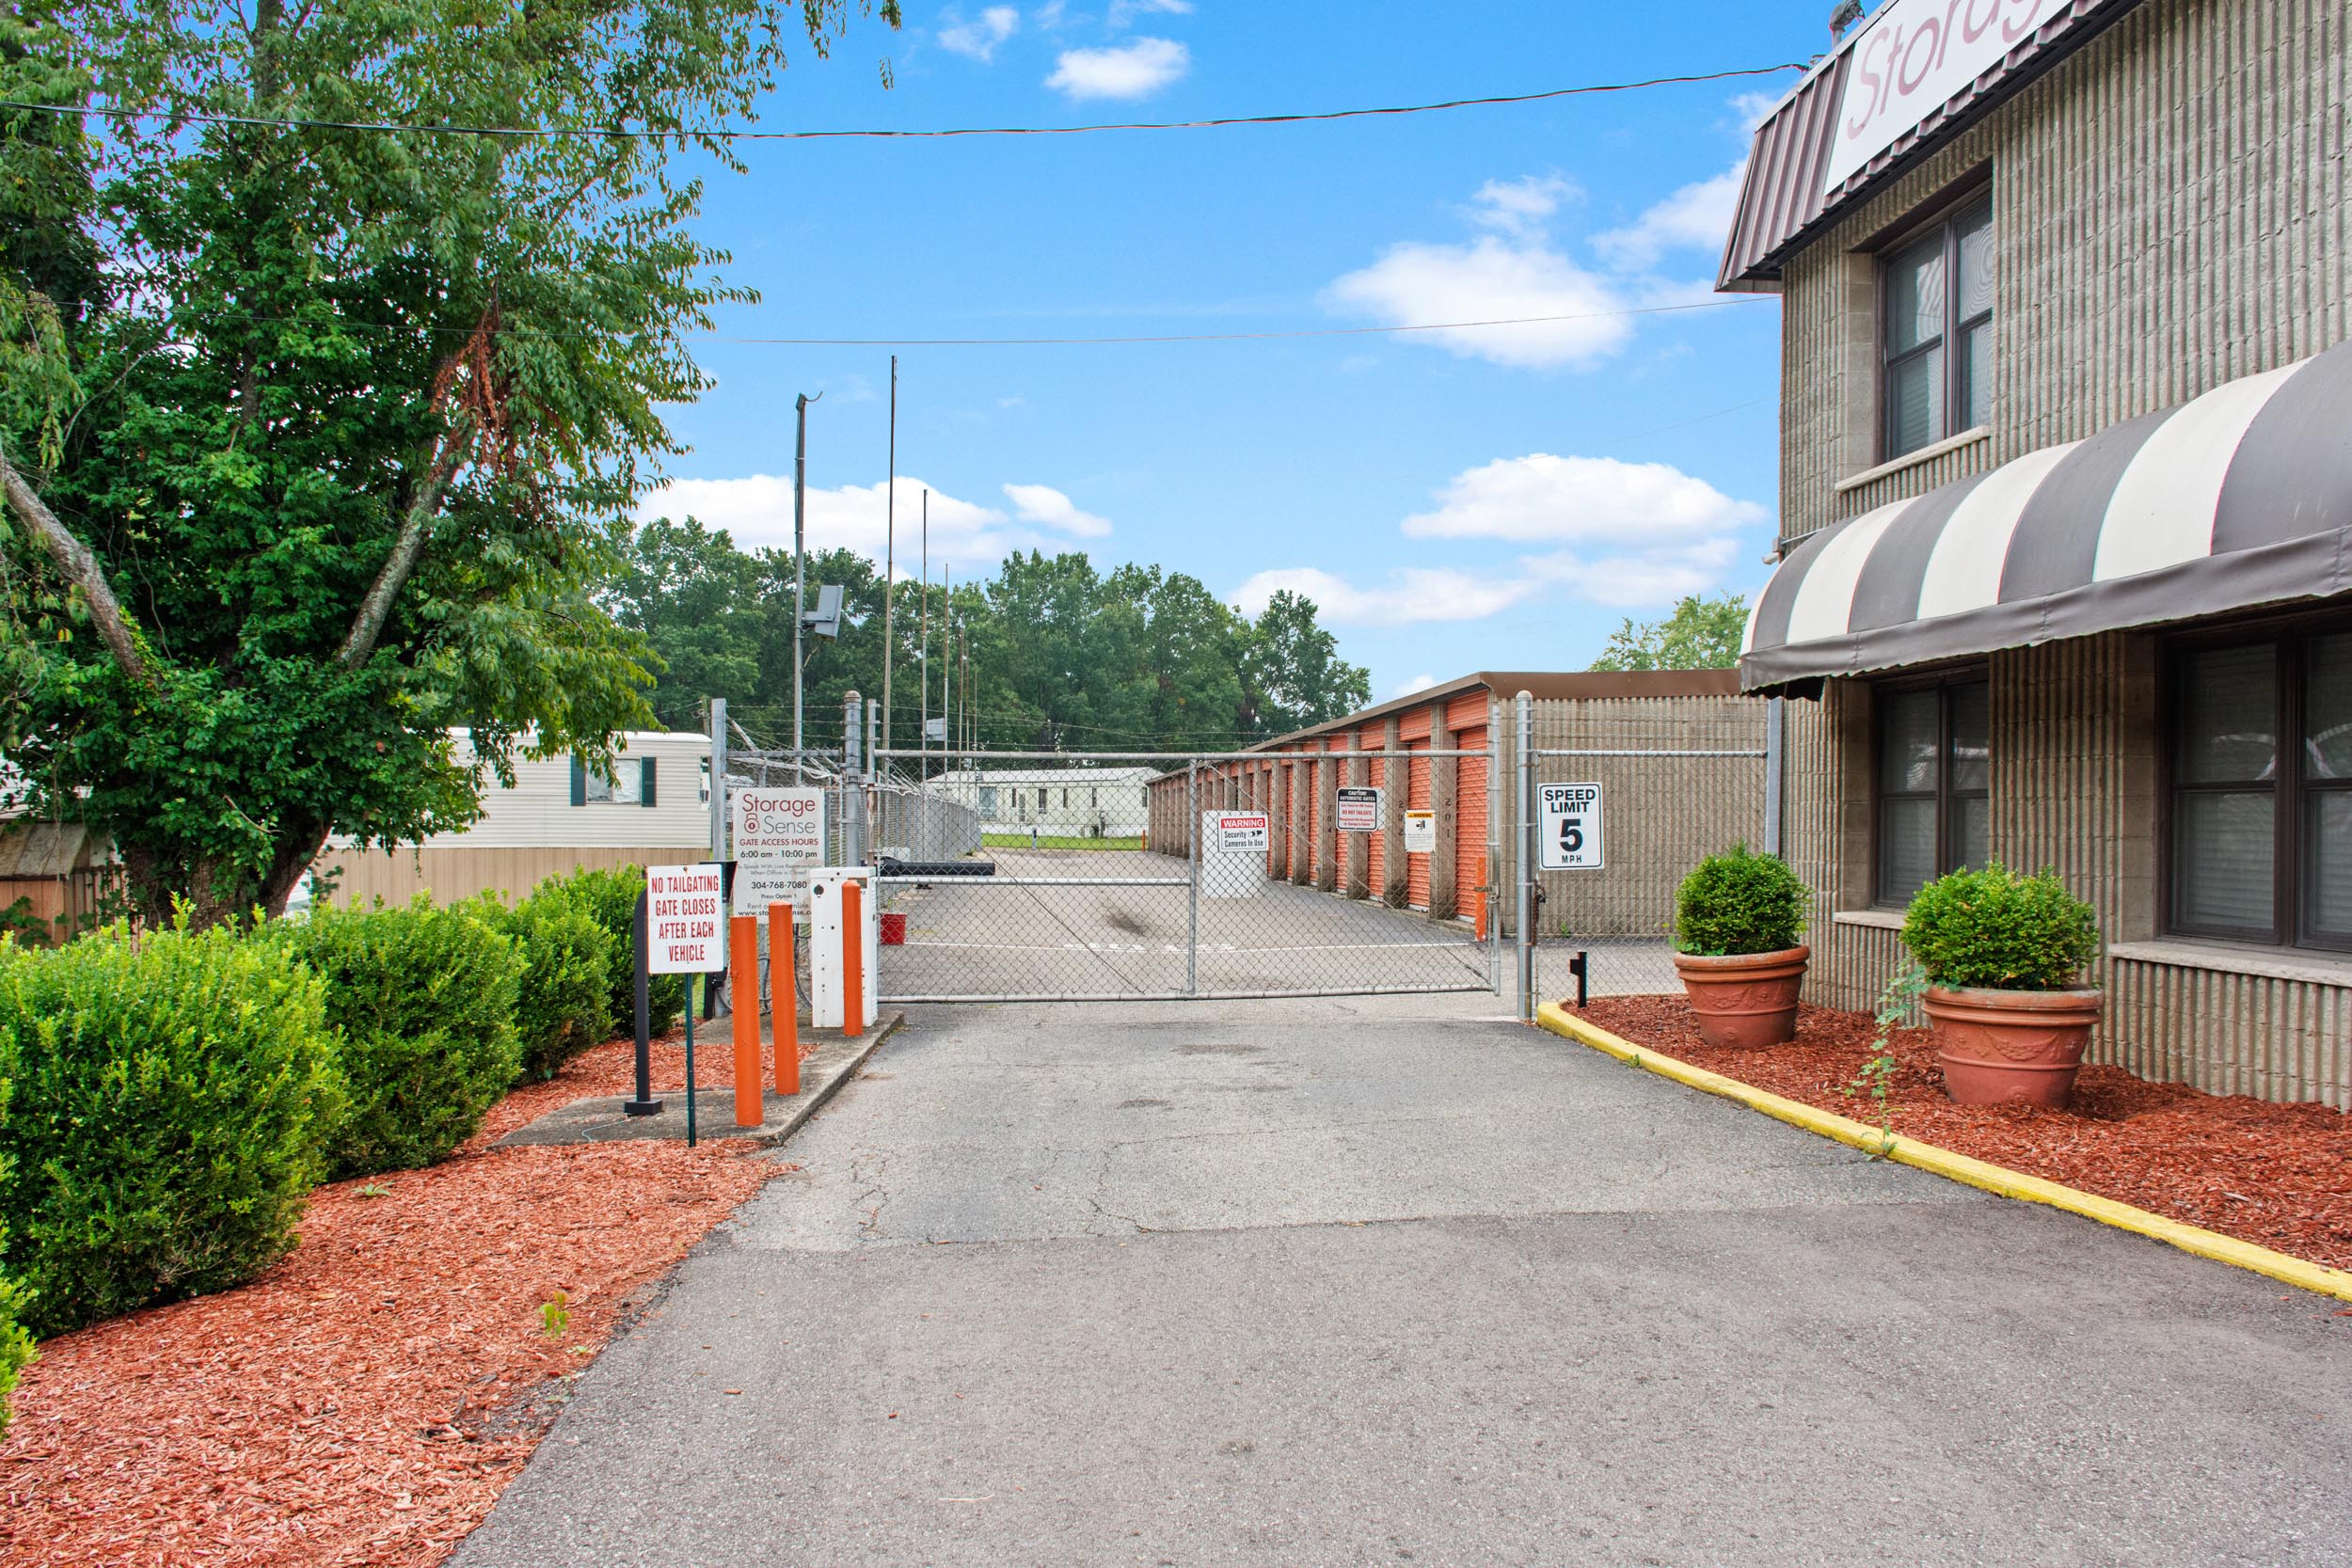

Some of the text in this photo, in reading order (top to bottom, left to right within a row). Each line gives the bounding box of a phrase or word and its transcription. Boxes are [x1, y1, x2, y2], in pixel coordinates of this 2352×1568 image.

[1545, 789, 1596, 801] SPEED
[742, 793, 816, 817] Storage
[1550, 801, 1590, 813] LIMIT
[763, 816, 816, 834] Sense
[1223, 819, 1263, 828] WARNING
[1559, 818, 1583, 852] 5
[1562, 855, 1582, 863] MPH
[651, 875, 719, 894] NO TAILGATING
[751, 881, 807, 890] 304-768-7080
[656, 898, 716, 916] GATE CLOSES
[659, 921, 714, 939] AFTER EACH
[668, 944, 706, 961] VEHICLE
